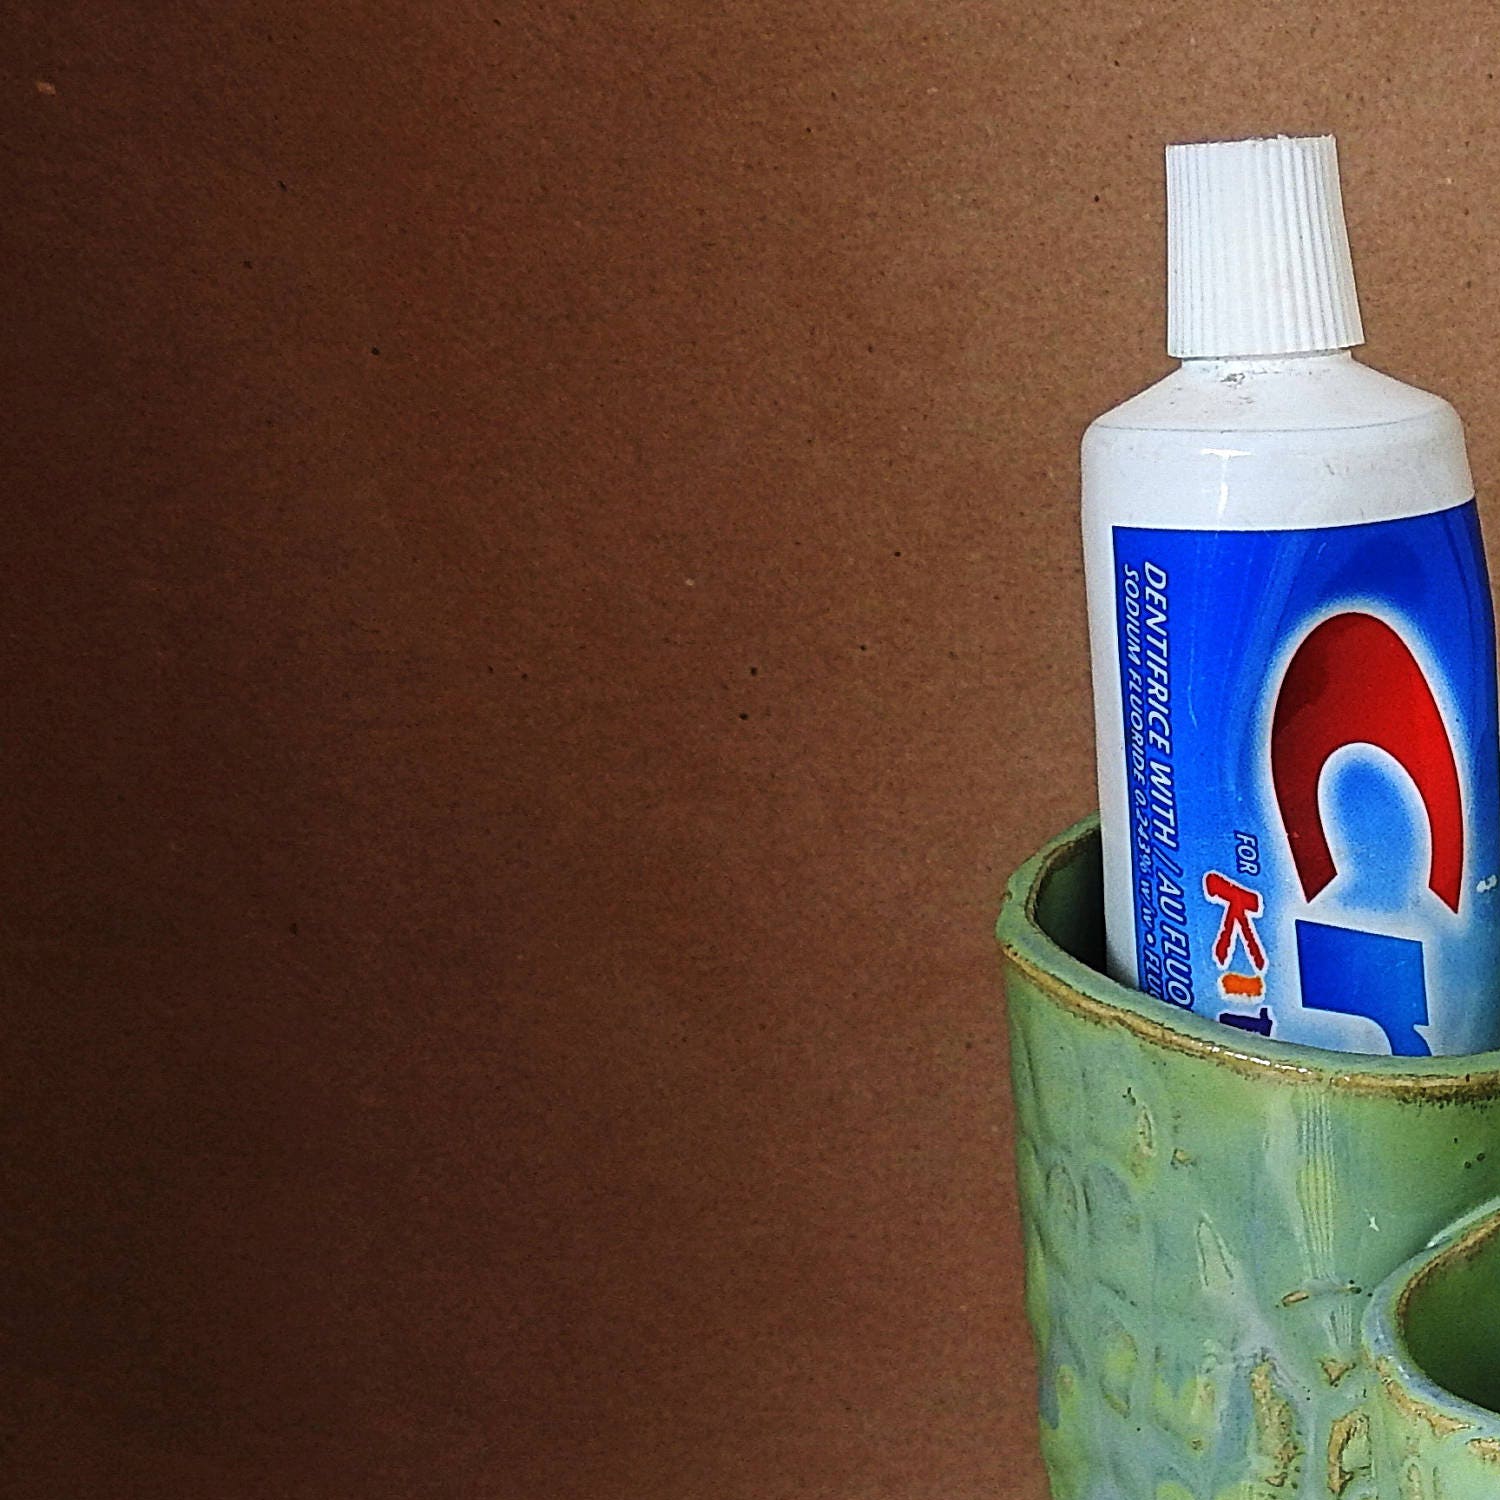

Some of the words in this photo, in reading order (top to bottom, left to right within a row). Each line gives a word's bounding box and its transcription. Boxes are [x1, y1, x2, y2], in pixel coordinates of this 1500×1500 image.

[1124, 563, 1142, 666] SODIUM
[1144, 561, 1170, 755] DENTIFRICE
[1128, 668, 1146, 786] FLUORIDE
[1135, 789, 1152, 874] 0.243%
[1150, 761, 1177, 848] WITH
[1158, 871, 1185, 922] AU
[1236, 833, 1257, 874] FOR
